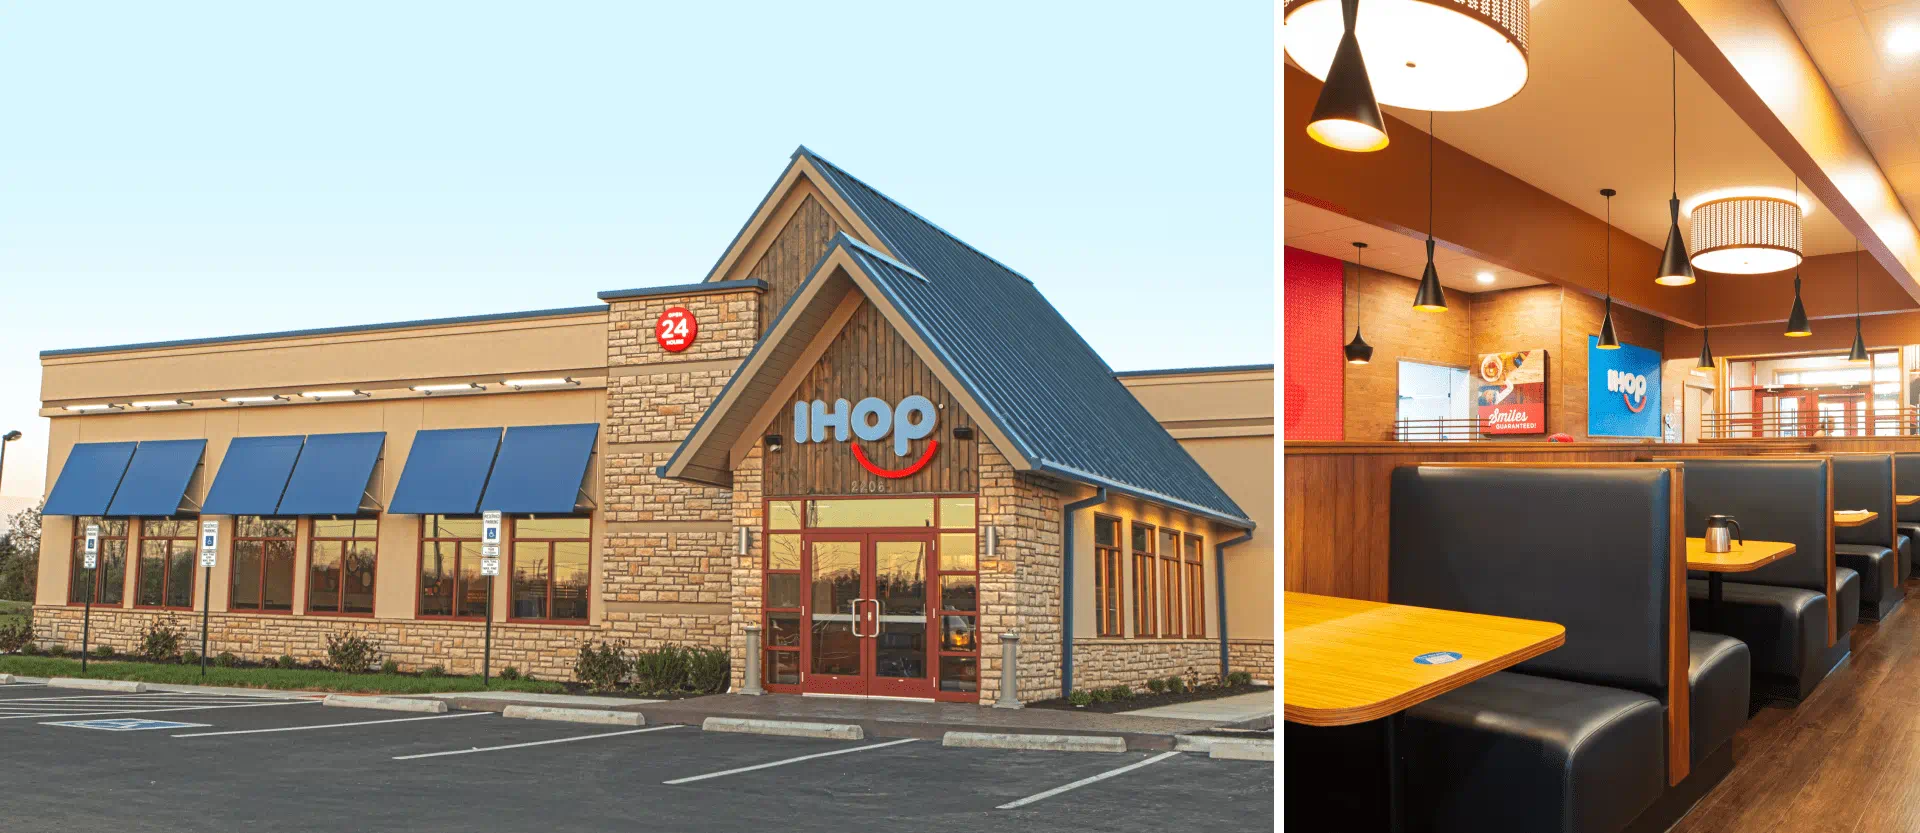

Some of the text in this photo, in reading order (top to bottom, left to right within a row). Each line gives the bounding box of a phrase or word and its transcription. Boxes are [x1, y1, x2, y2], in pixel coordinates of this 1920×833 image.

[661, 317, 689, 339] 24
[1607, 369, 1647, 404] IHOP
[794, 394, 938, 457] IHOP
[1488, 407, 1529, 426] Smiles
[1495, 422, 1537, 430] GUARANTEED!
